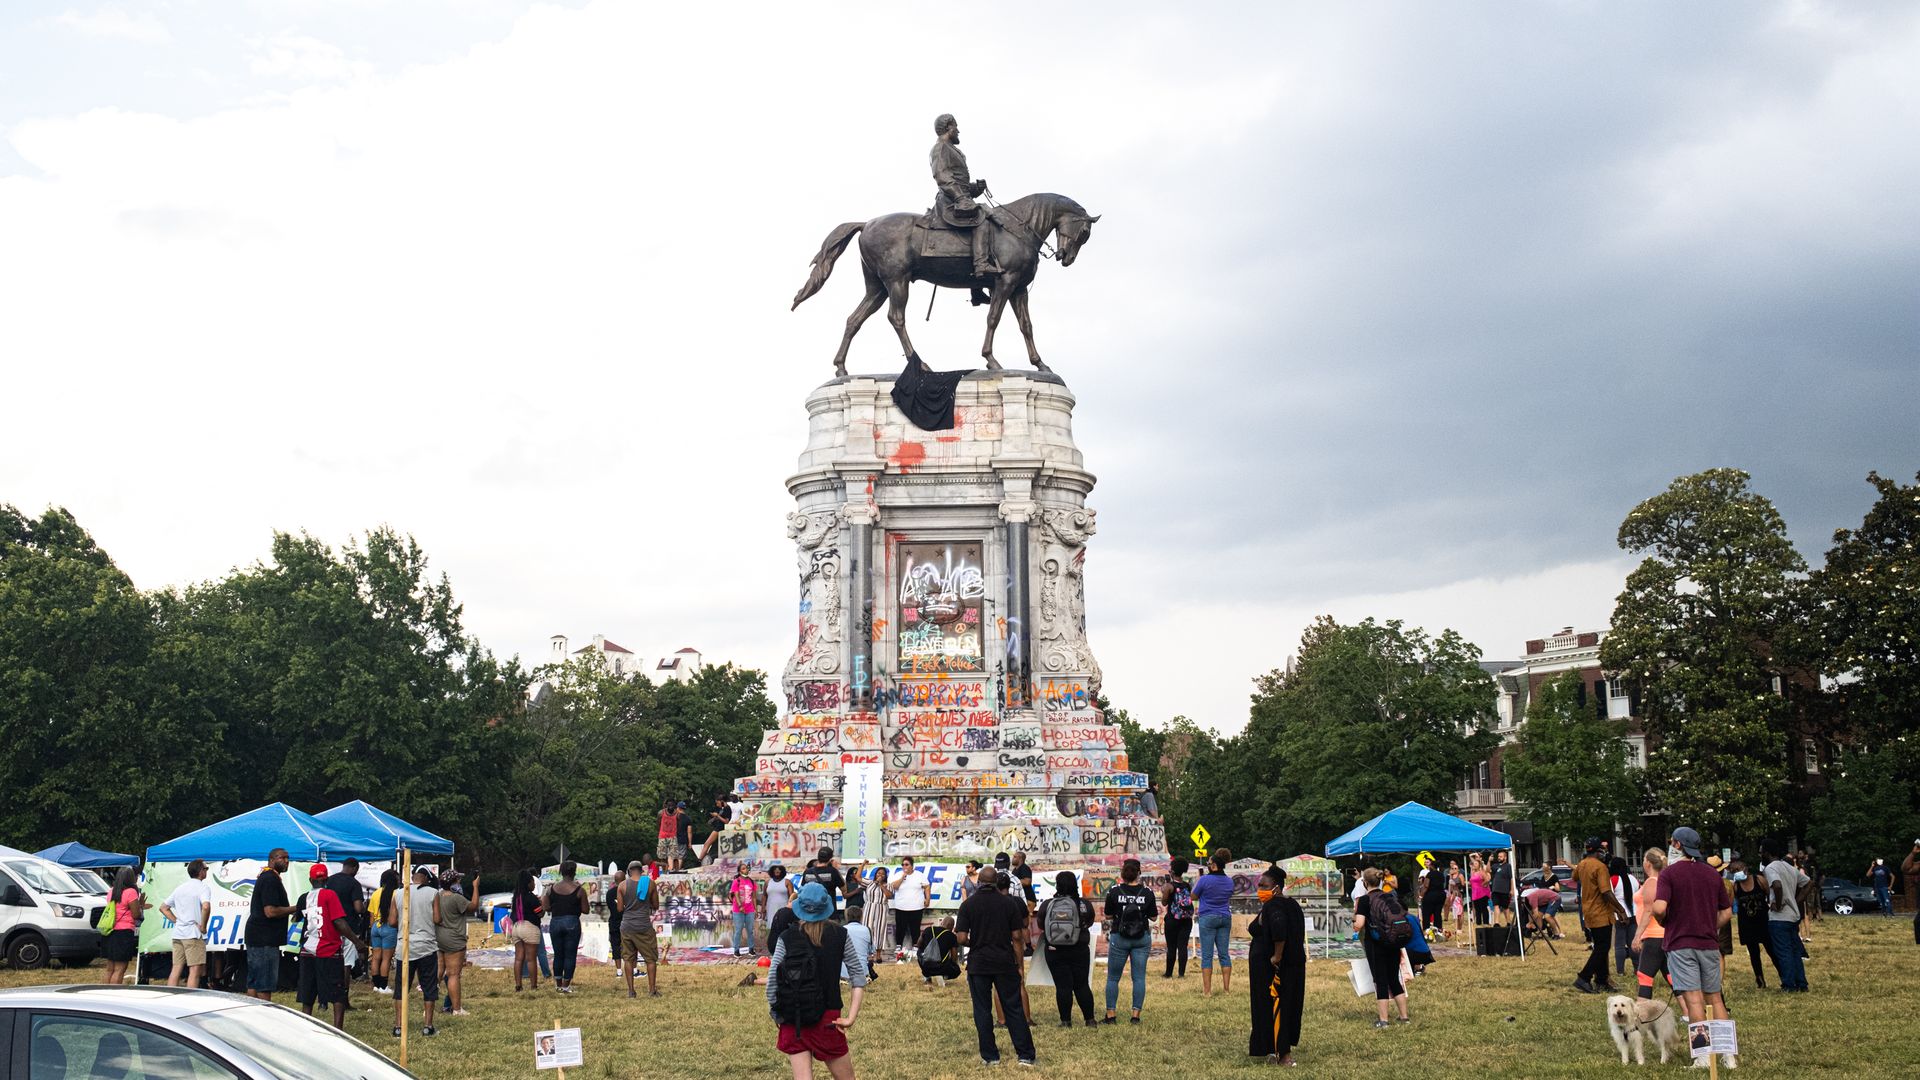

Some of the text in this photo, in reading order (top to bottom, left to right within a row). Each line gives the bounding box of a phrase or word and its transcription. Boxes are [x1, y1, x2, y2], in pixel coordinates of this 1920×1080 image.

[1042, 728, 1081, 742] HOLD
[1055, 740, 1083, 750] COPS
[858, 774, 867, 856] THINK TANK
